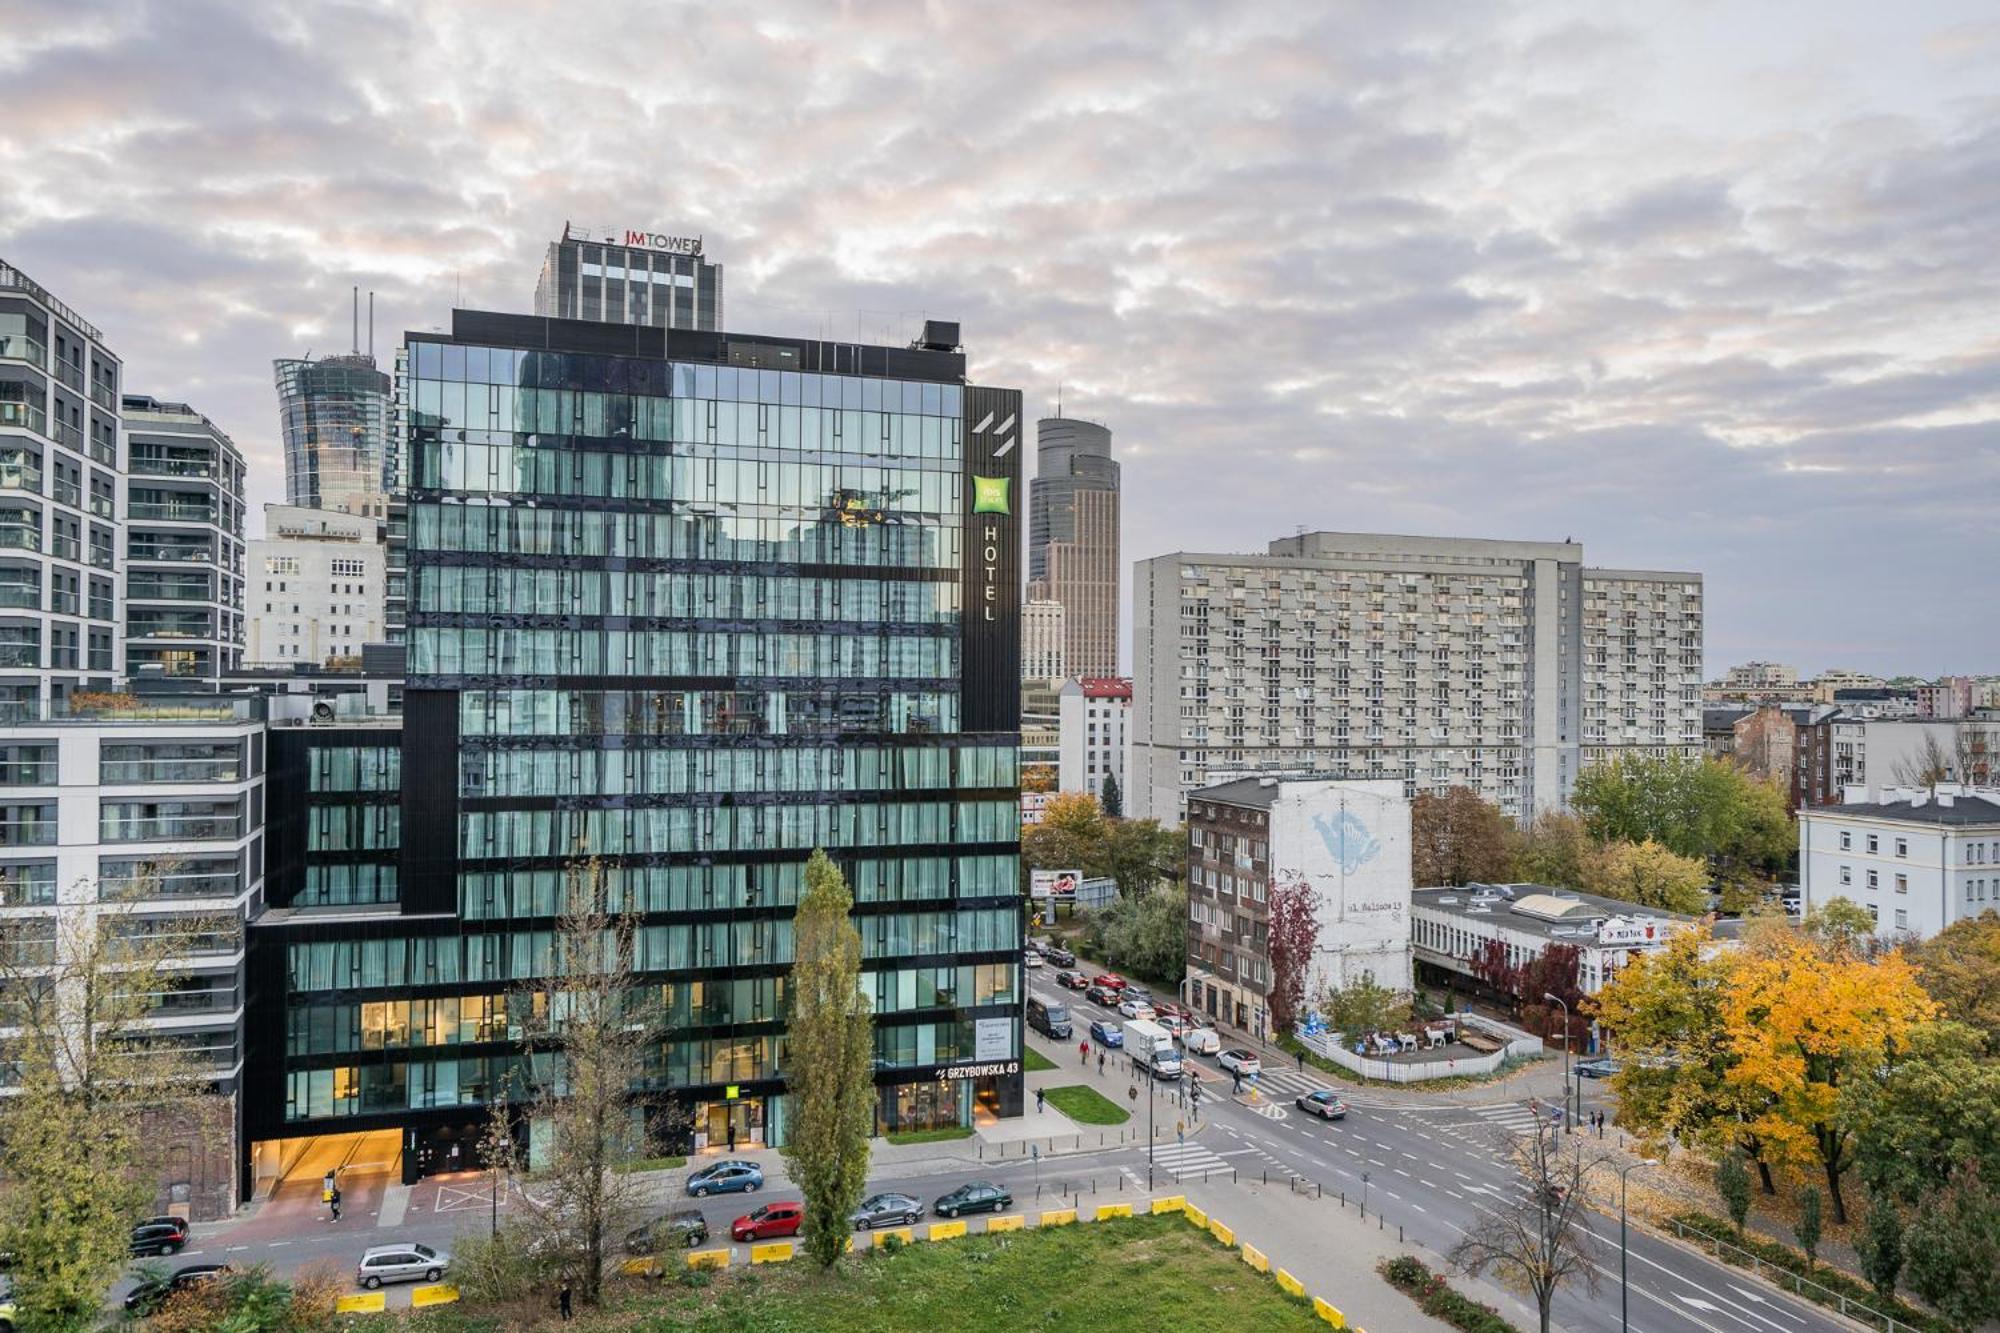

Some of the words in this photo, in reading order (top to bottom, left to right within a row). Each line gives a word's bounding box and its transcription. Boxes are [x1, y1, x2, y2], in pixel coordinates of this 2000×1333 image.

[984, 526, 997, 621] HOTEL
[947, 1063, 1005, 1079] GRZYBOWSKA
[1007, 1062, 1019, 1075] 43
